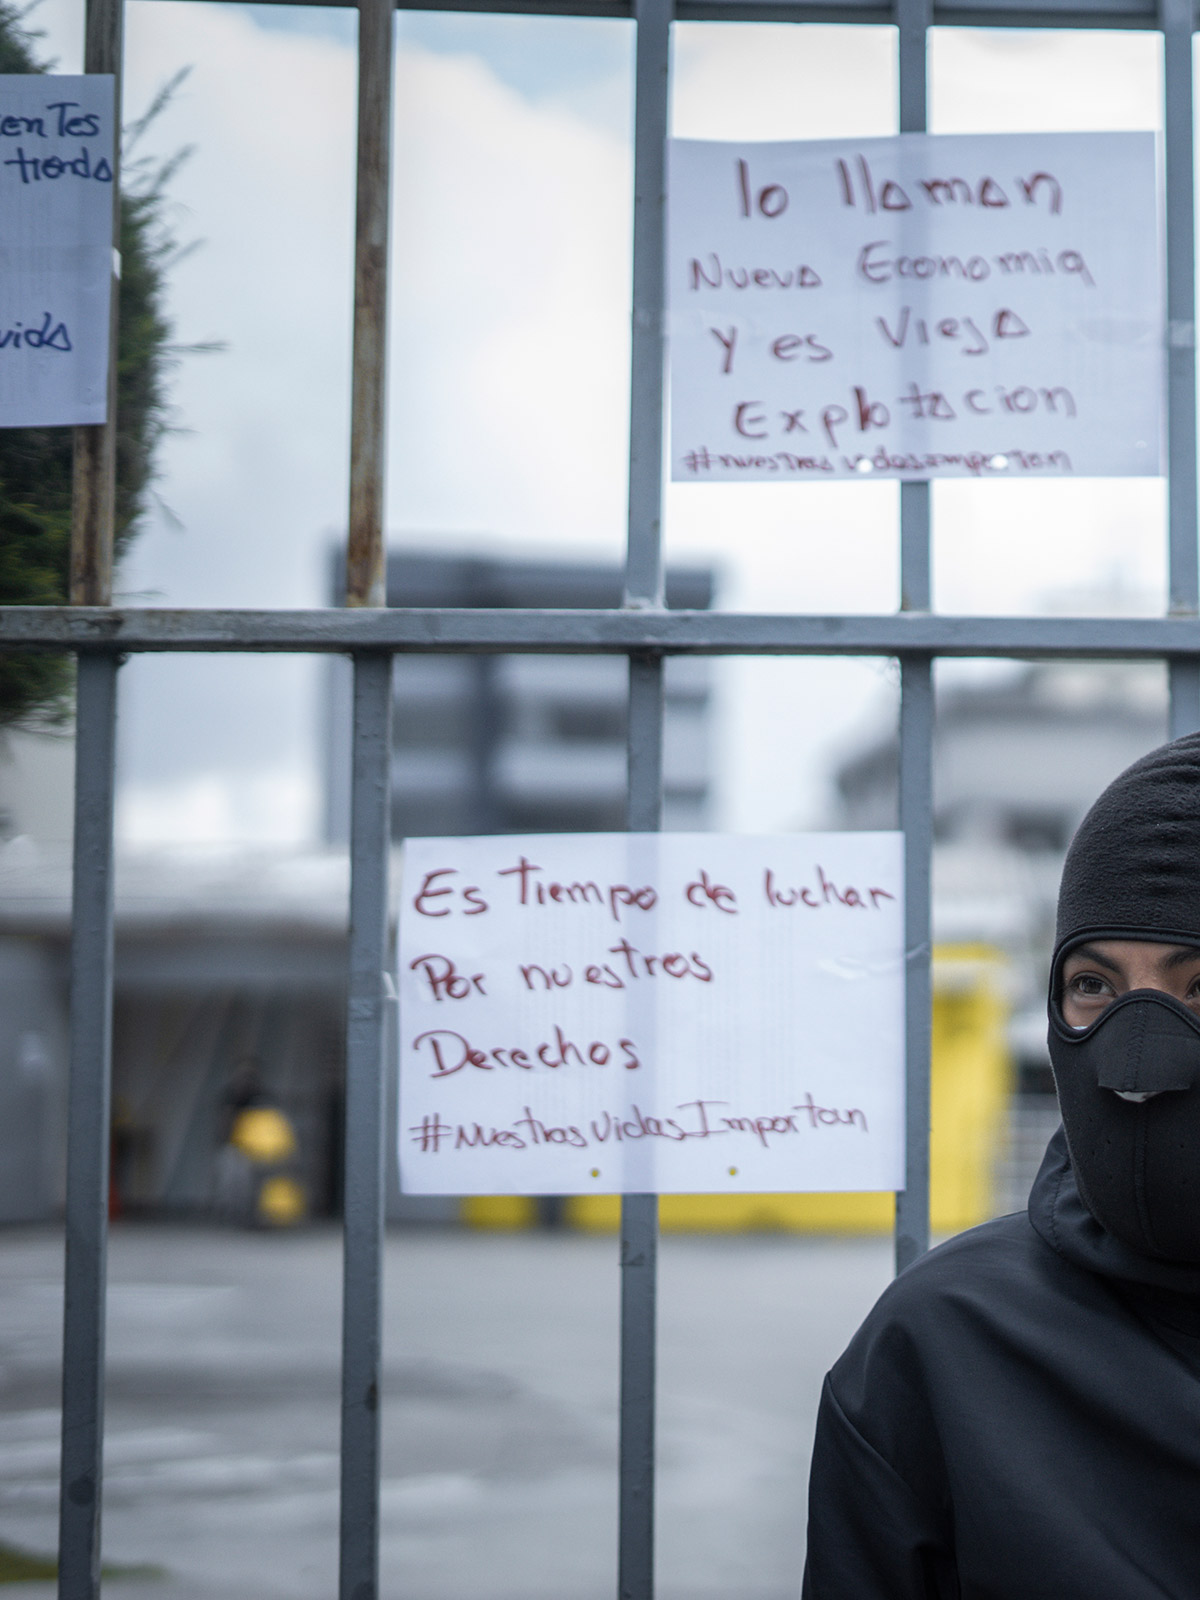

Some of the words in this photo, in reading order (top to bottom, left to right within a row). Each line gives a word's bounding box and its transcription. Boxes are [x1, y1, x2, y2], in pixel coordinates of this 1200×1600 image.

[0, 102, 99, 138] enTes
[736, 158, 789, 218] lo
[837, 154, 1062, 216] llaman
[690, 254, 822, 291] Nueva
[858, 240, 1096, 288] Economia
[770, 333, 834, 363] es
[414, 868, 490, 917] Es
[686, 868, 741, 915] de
[763, 863, 898, 911] luchar
[411, 953, 487, 1002] Por
[519, 938, 714, 992] nuestros
[413, 1024, 641, 1079] Derechos
